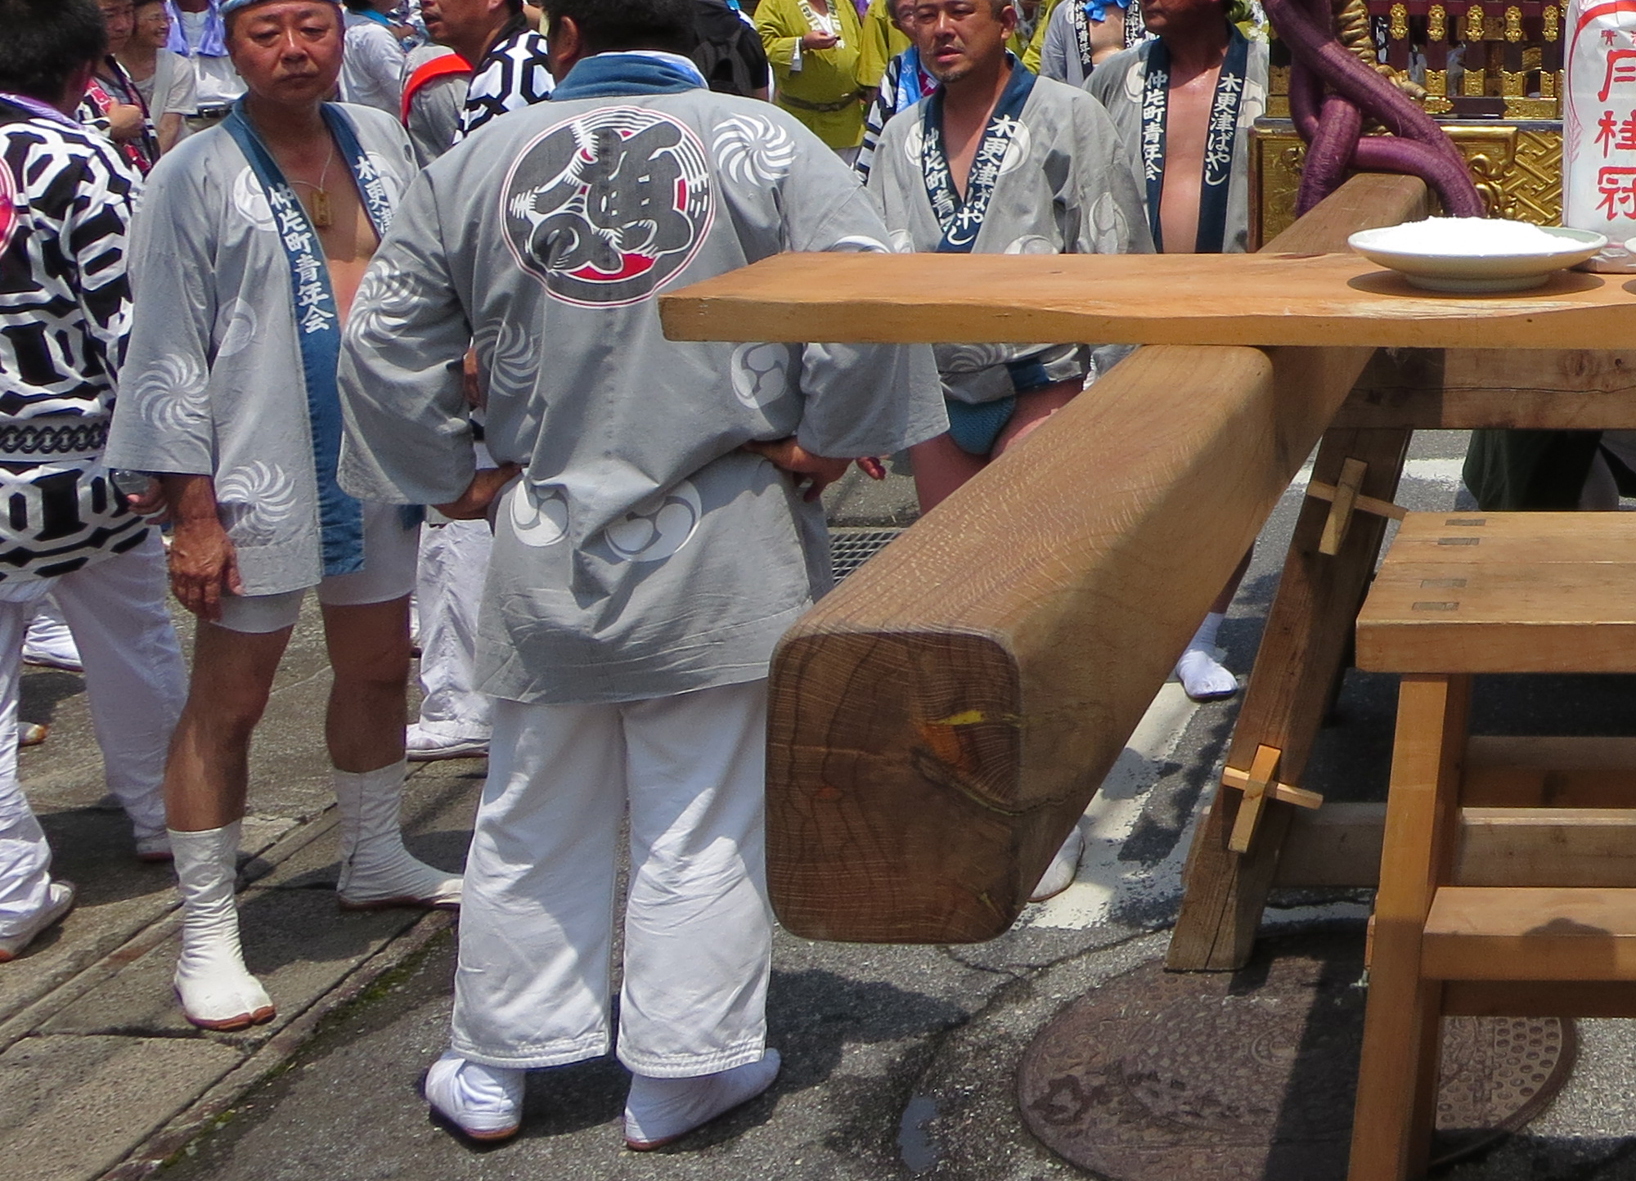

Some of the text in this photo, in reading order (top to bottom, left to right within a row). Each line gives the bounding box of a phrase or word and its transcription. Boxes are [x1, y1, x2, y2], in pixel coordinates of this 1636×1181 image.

[947, 114, 1016, 246] 木更津ばやし
[1143, 69, 1169, 181] 仲片町青年会
[1205, 72, 1242, 186] 木更津ばやし
[267, 182, 335, 334] 仲片町青年会
